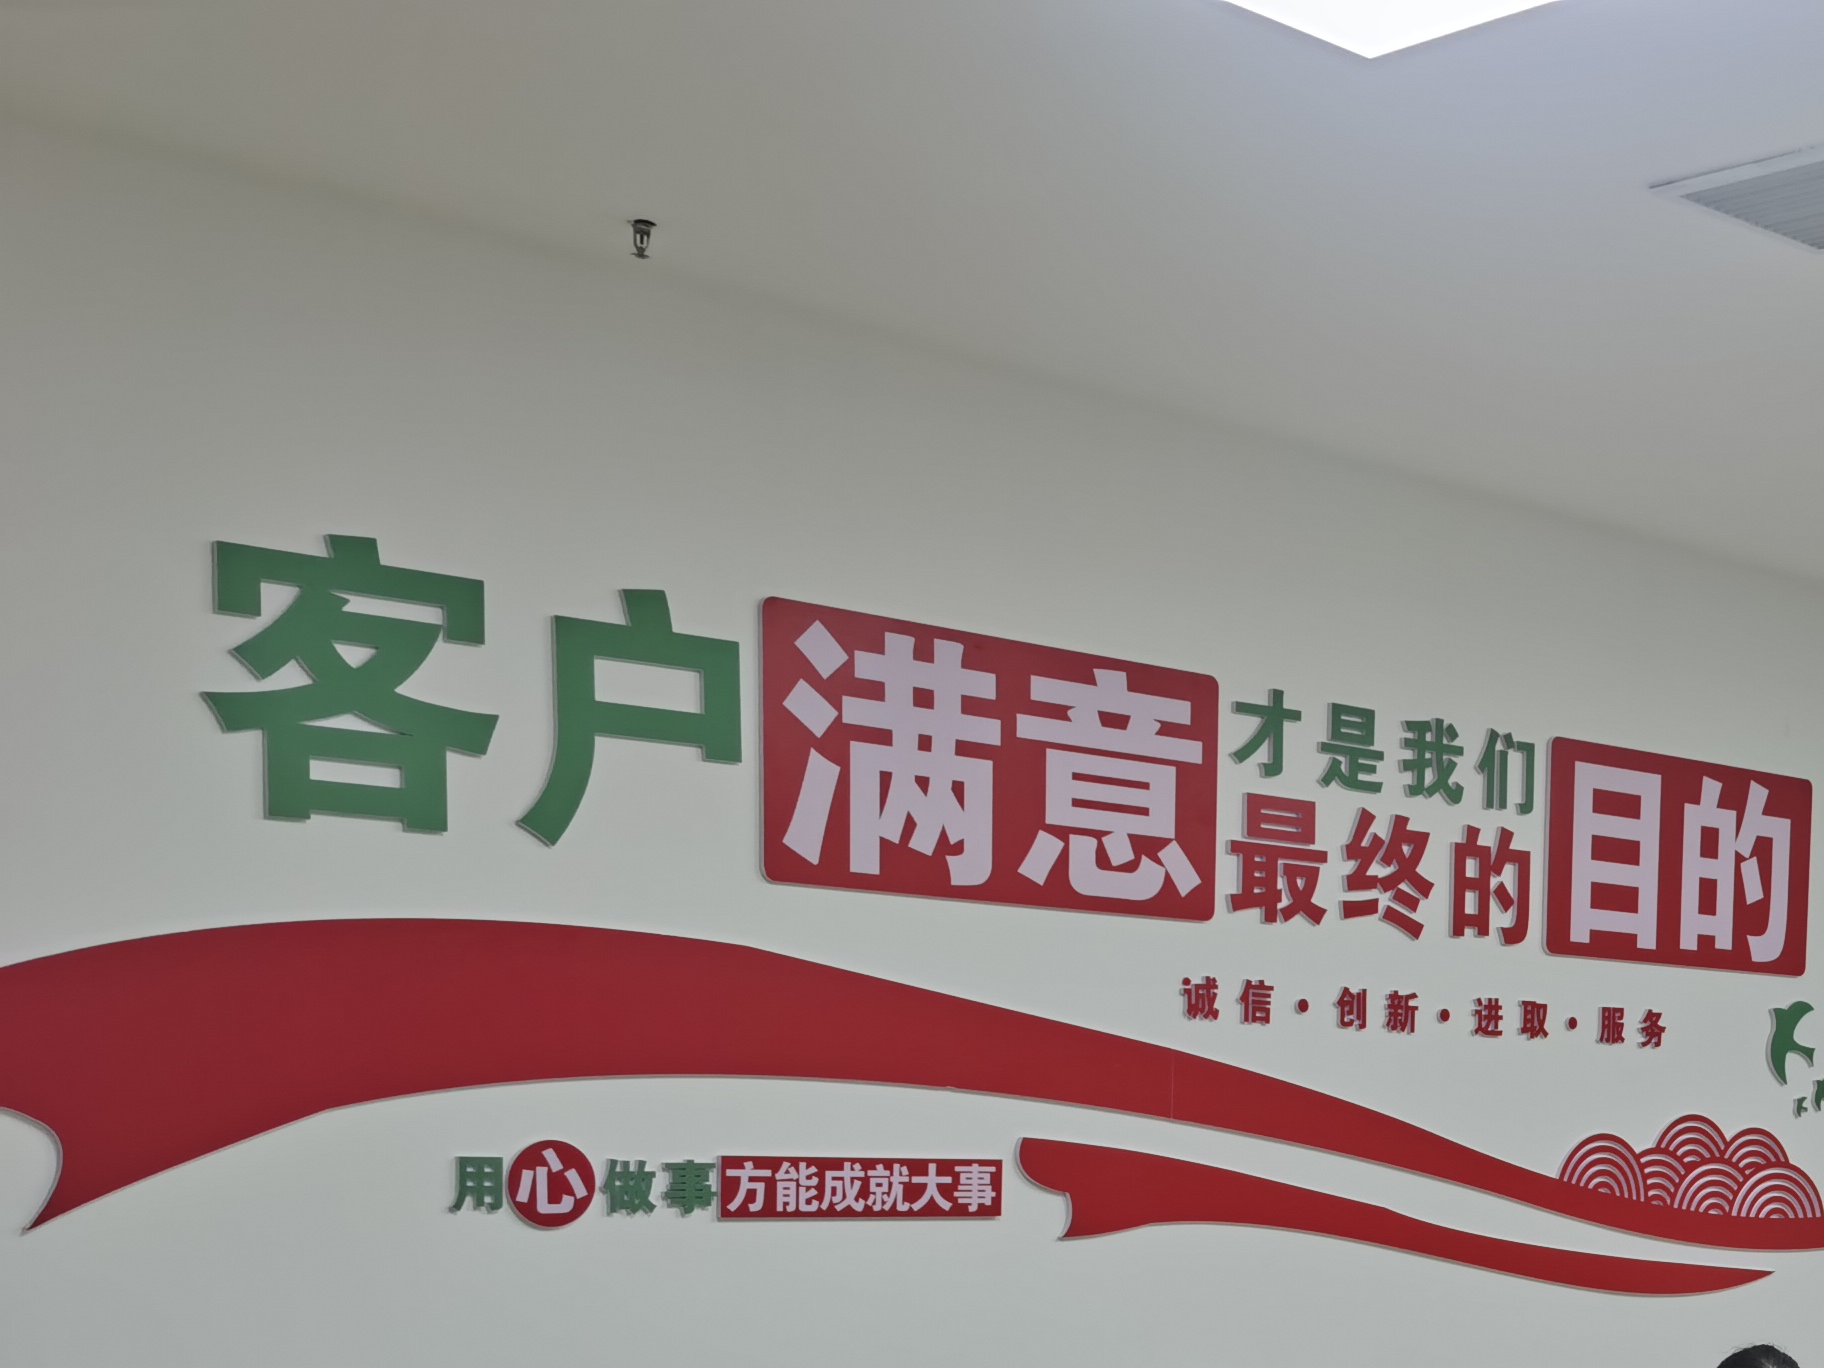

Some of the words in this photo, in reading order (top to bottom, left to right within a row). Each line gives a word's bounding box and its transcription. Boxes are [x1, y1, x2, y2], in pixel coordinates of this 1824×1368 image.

[1228, 688, 1536, 816] 才是我们
[1225, 791, 1534, 946] 最终的
[1569, 760, 1792, 963] 目的
